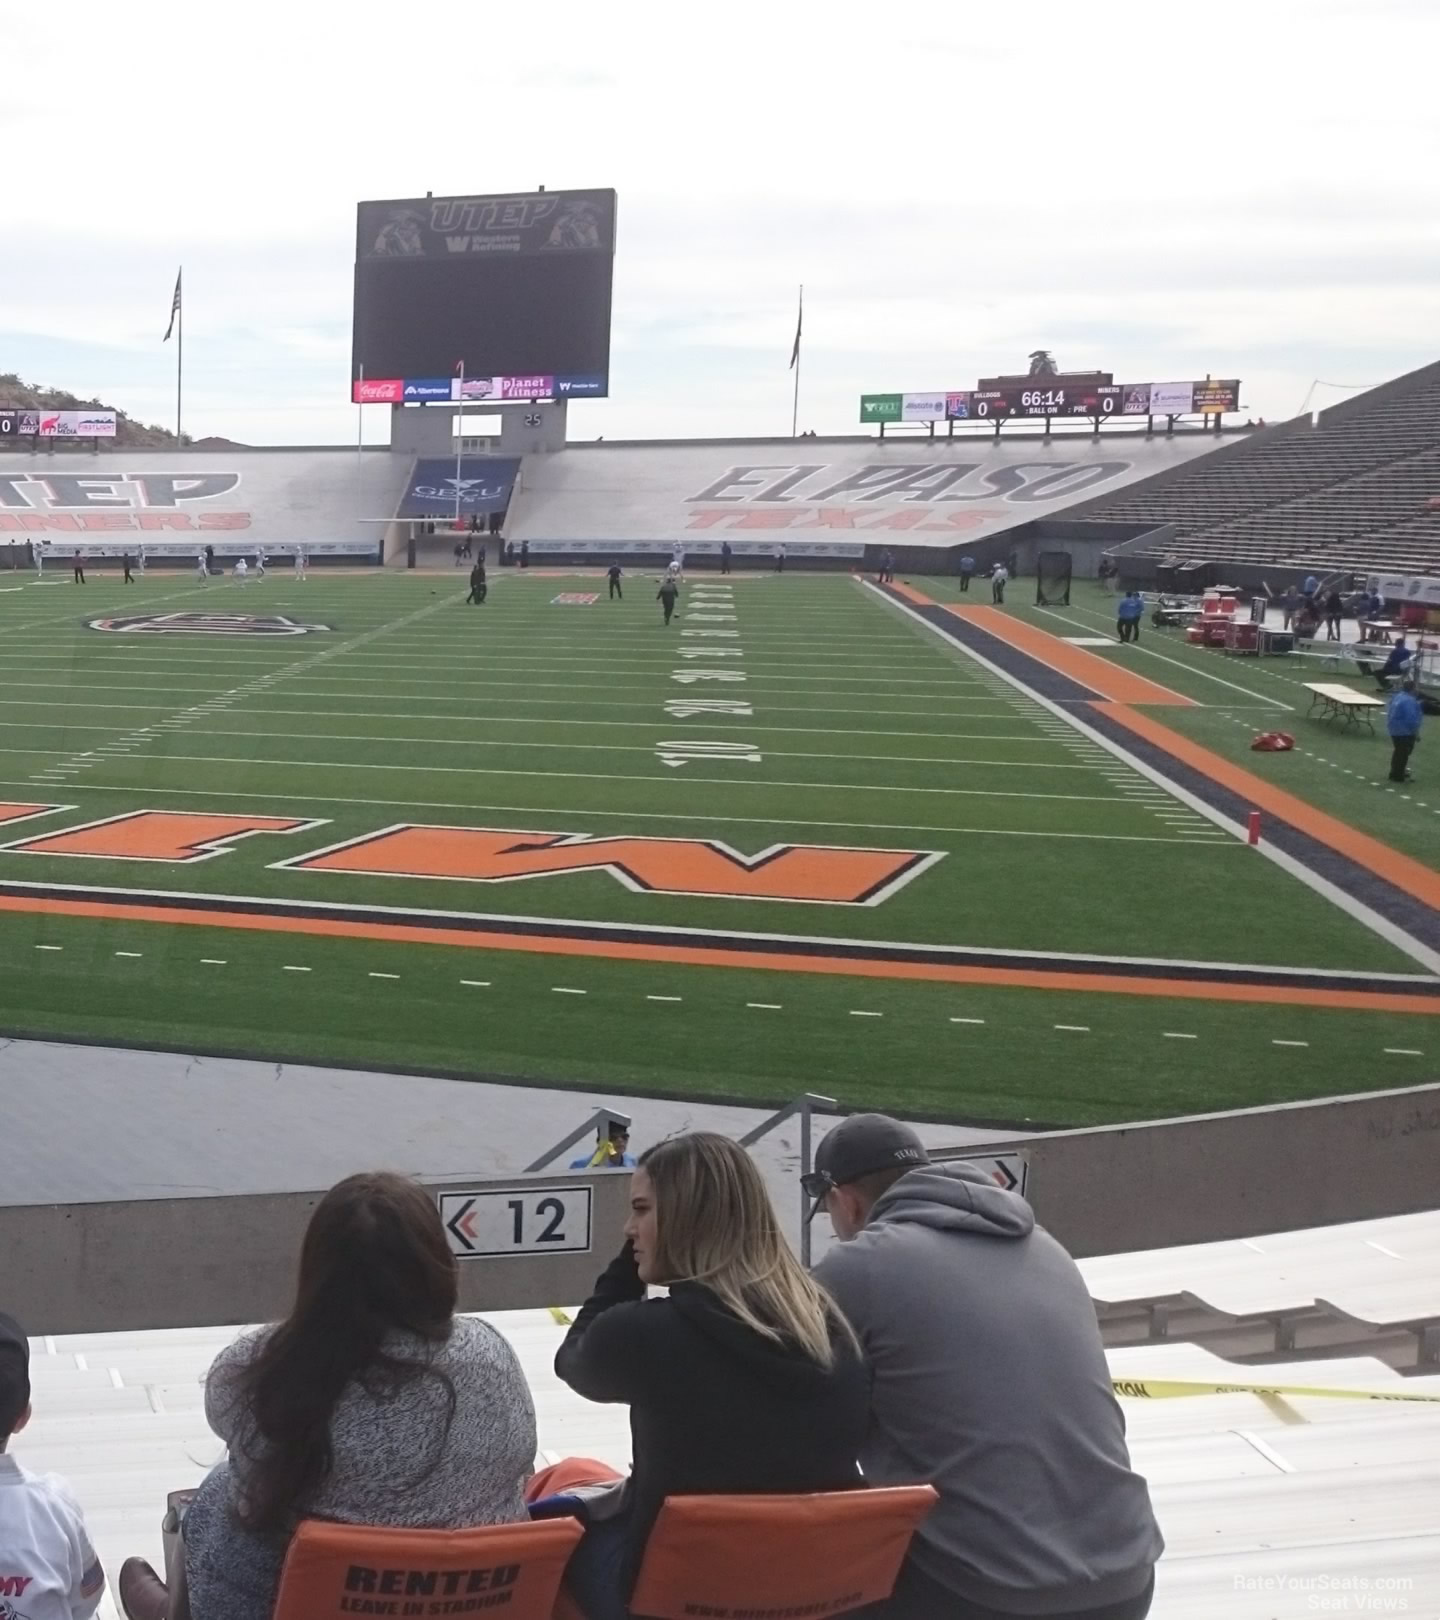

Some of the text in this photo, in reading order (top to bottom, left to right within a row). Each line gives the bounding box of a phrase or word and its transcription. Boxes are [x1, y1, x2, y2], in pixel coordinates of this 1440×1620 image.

[430, 196, 560, 232] UTEP
[472, 235, 520, 243] Western
[472, 243, 520, 252] Refining
[503, 378, 545, 391] planet
[508, 387, 553, 398] fitness
[1022, 391, 1065, 406] 66:14
[978, 402, 988, 416] 0
[1103, 398, 1113, 412] 0
[1, 420, 10, 432] 0
[683, 461, 1135, 503] EL PASO
[415, 486, 505, 497] GECU
[688, 508, 1011, 531] TEXAS
[508, 1198, 566, 1243] 12
[1112, 1382, 1152, 1399] TION
[344, 1564, 521, 1596] RENTED
[340, 1591, 513, 1616] LEAVE IN STADIUM
